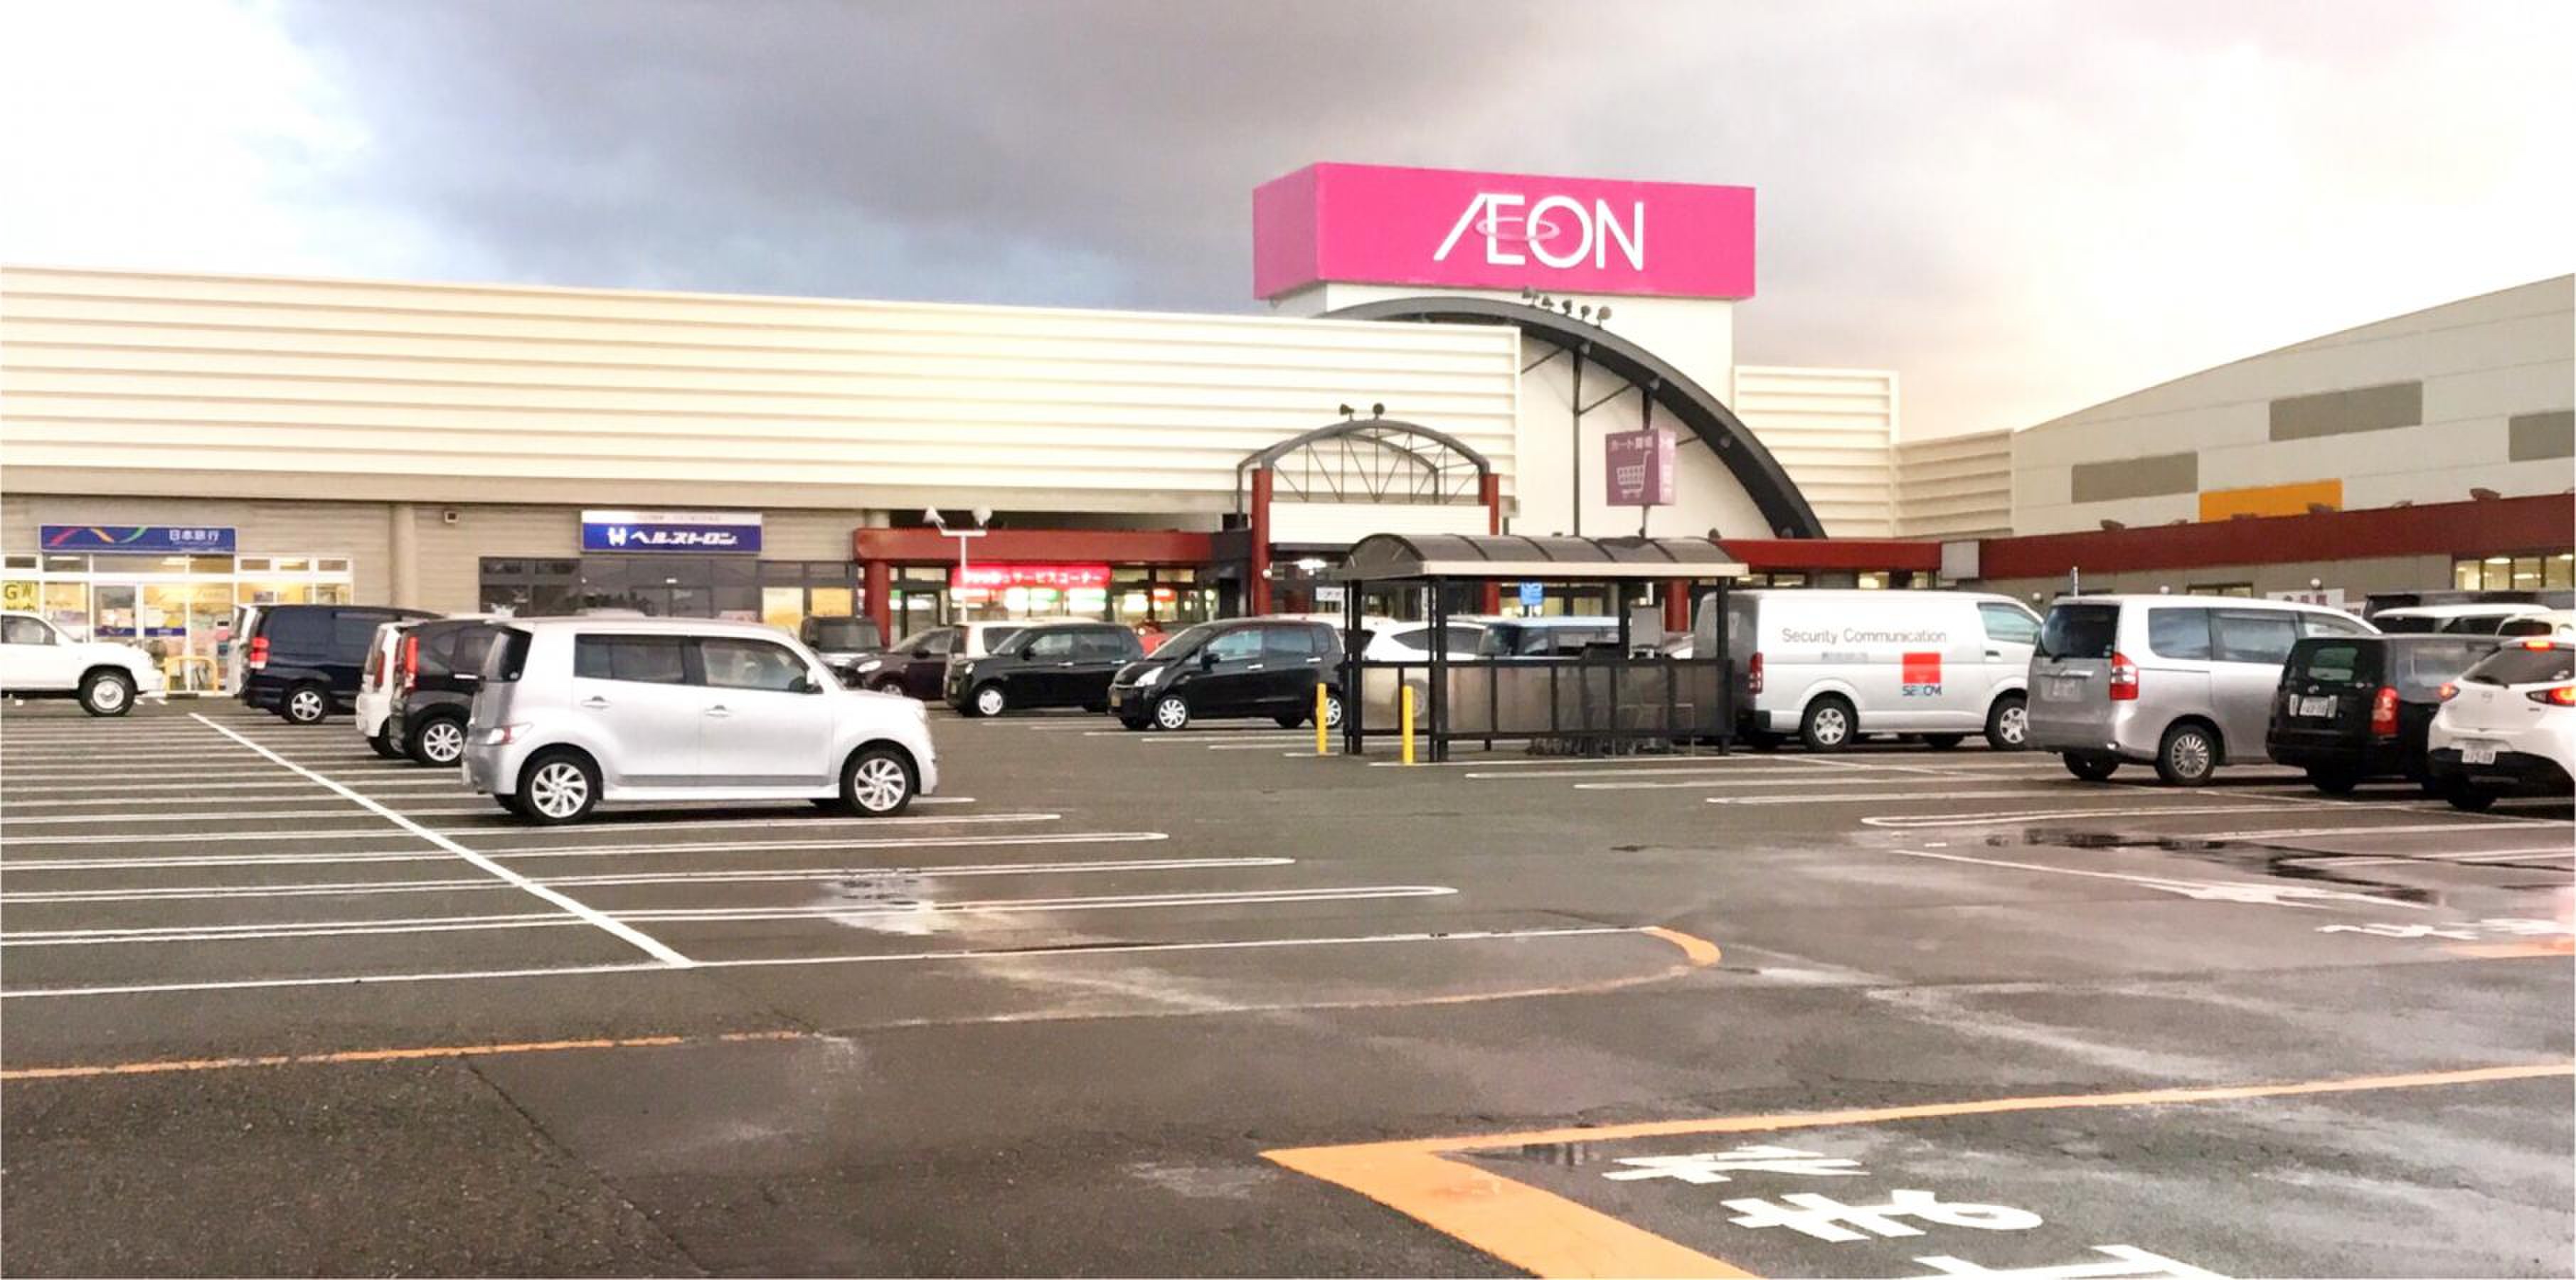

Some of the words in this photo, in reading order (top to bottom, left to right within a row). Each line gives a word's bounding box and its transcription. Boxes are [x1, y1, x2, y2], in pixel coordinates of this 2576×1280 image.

[629, 530, 738, 545] ヘルストロン
[1782, 628, 1838, 644] Security
[1843, 628, 1947, 643] Communication
